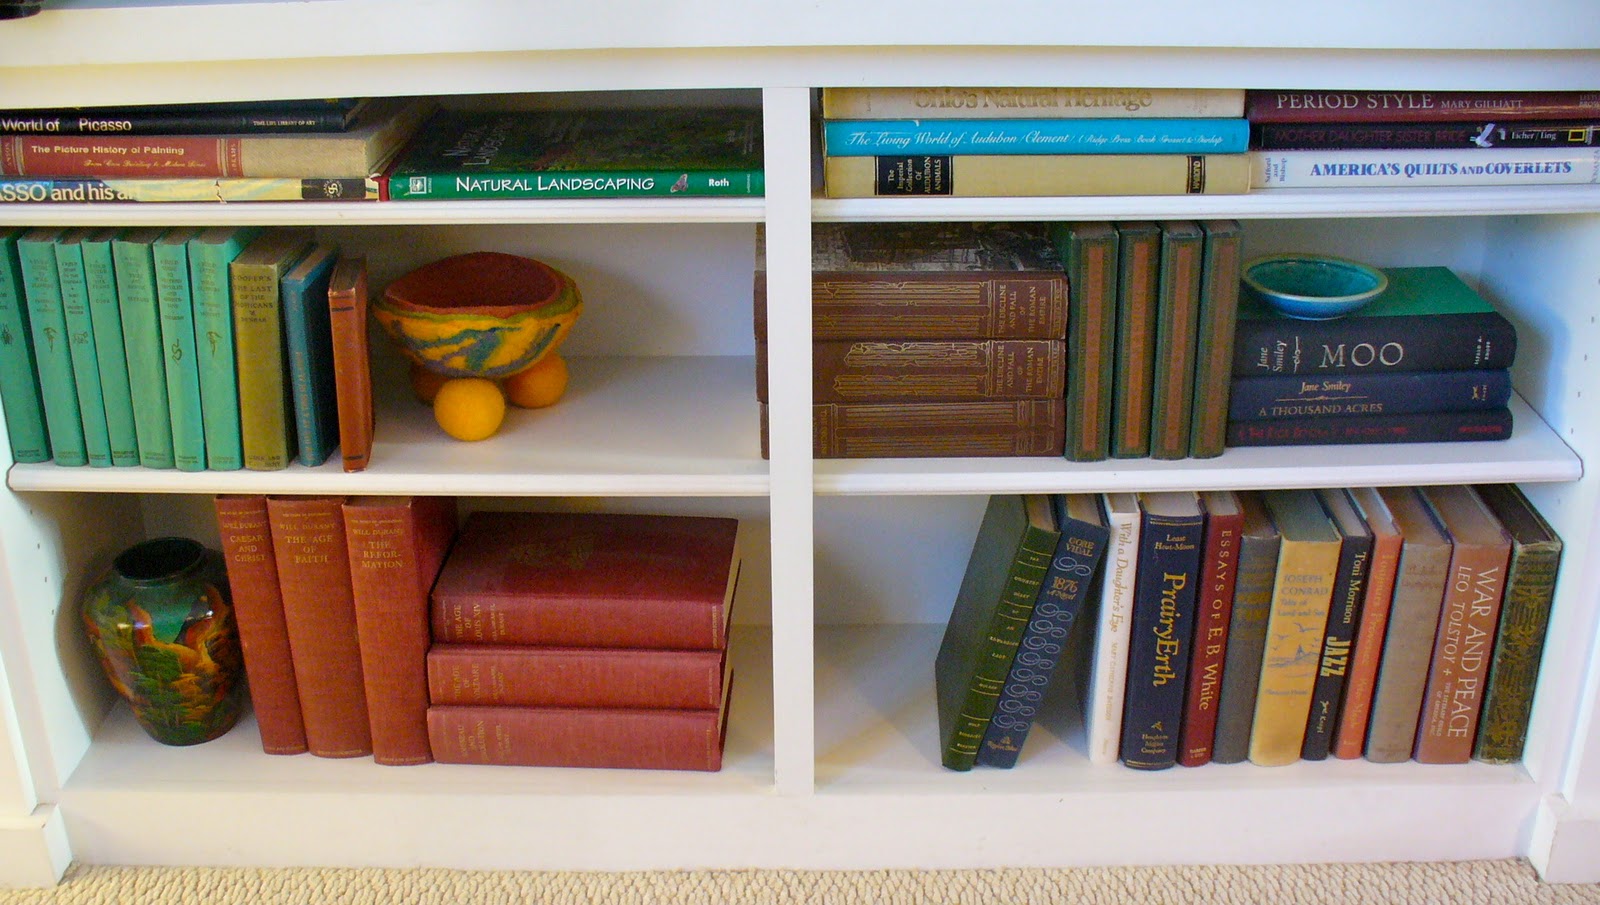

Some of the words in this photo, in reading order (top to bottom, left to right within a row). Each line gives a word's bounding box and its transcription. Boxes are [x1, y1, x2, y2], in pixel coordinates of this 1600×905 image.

[983, 88, 1058, 108] Natural
[1064, 88, 1152, 111] Heritage
[1276, 94, 1359, 109] PERIOD
[1367, 93, 1435, 109] STYLE
[1441, 100, 1471, 109] MARY
[1475, 99, 1524, 109] GILLIATT
[2, 118, 43, 132] World
[46, 119, 60, 132] of
[79, 118, 132, 131] Picasso
[845, 131, 872, 146] The
[873, 131, 911, 149] Living
[914, 131, 950, 146] World
[951, 132, 967, 149] of
[963, 130, 1017, 146] Audubon
[1025, 130, 1070, 144] Clement
[31, 145, 51, 154] The
[54, 145, 89, 154] Picture
[92, 145, 128, 155] History
[131, 145, 140, 154] of
[144, 145, 185, 156] Painting
[887, 169, 895, 182] The
[897, 161, 905, 190] Imperial
[905, 158, 913, 193] Collection
[924, 156, 932, 194] AUDUBON
[934, 158, 942, 191] ANIMALS
[1279, 157, 1288, 182] Bishop
[1310, 163, 1400, 177] AMERICA'S
[1404, 162, 1458, 178] QUILTS
[1459, 165, 1484, 175] AND
[1485, 161, 1572, 175] COVERLETS
[51, 183, 85, 201] and
[88, 182, 114, 201] his
[456, 176, 532, 192] NATURAL
[537, 175, 655, 192] LANDSCAPING
[708, 177, 730, 188] Roth
[250, 285, 273, 293] LAST
[999, 284, 1007, 319] DECLINE
[1009, 290, 1017, 312] FALL
[1028, 286, 1036, 317] ROMAN
[1026, 346, 1034, 376] ROMAN
[1257, 346, 1270, 371] Jane
[1272, 339, 1288, 373] Smiley
[1319, 342, 1404, 369] MOO
[1299, 381, 1320, 395] Jane
[1323, 380, 1352, 393] Smiley
[1258, 407, 1267, 416] A
[1271, 404, 1342, 416] THOUSAND
[1345, 403, 1383, 415] ACRES
[279, 522, 298, 531] WILL
[301, 522, 336, 531] DURANT
[352, 527, 370, 536] WILL
[372, 527, 403, 537] DURANT
[1118, 522, 1132, 546] With
[229, 534, 264, 543] CAESAR
[284, 535, 307, 544] THE
[312, 534, 333, 544] AGE
[368, 541, 391, 549] THE
[1068, 536, 1095, 550] GORE
[1166, 533, 1187, 542] Least
[238, 544, 258, 553] AND
[302, 545, 316, 554] OF
[1066, 543, 1093, 557] VIDAL
[234, 553, 266, 563] CHRIST
[294, 554, 329, 564] FAITH
[360, 559, 403, 569] MATION
[1215, 530, 1232, 592] ESSAYS
[1351, 551, 1367, 577] Toni
[1051, 576, 1079, 593] 1876
[1112, 558, 1128, 613] Daughter's
[1284, 574, 1322, 583] JOSEPH
[1455, 565, 1472, 593] LEO
[1281, 587, 1329, 596] CONRAD
[1470, 566, 1499, 618] WAR
[1211, 599, 1223, 620] OF
[1343, 578, 1362, 624] Morrison
[453, 604, 462, 623] AGE
[473, 603, 481, 619] XIV
[1297, 609, 1312, 617] and
[464, 617, 472, 628] OF
[1110, 613, 1124, 633] Eye
[1153, 572, 1187, 688] PrairyErth
[1207, 627, 1223, 641] E.
[1443, 602, 1466, 664] TOLSTOY
[1205, 644, 1221, 658] B.
[1460, 623, 1487, 672] AND
[1320, 636, 1351, 678] JAZZ
[1198, 662, 1219, 711] White
[1447, 676, 1478, 738] PEACE
